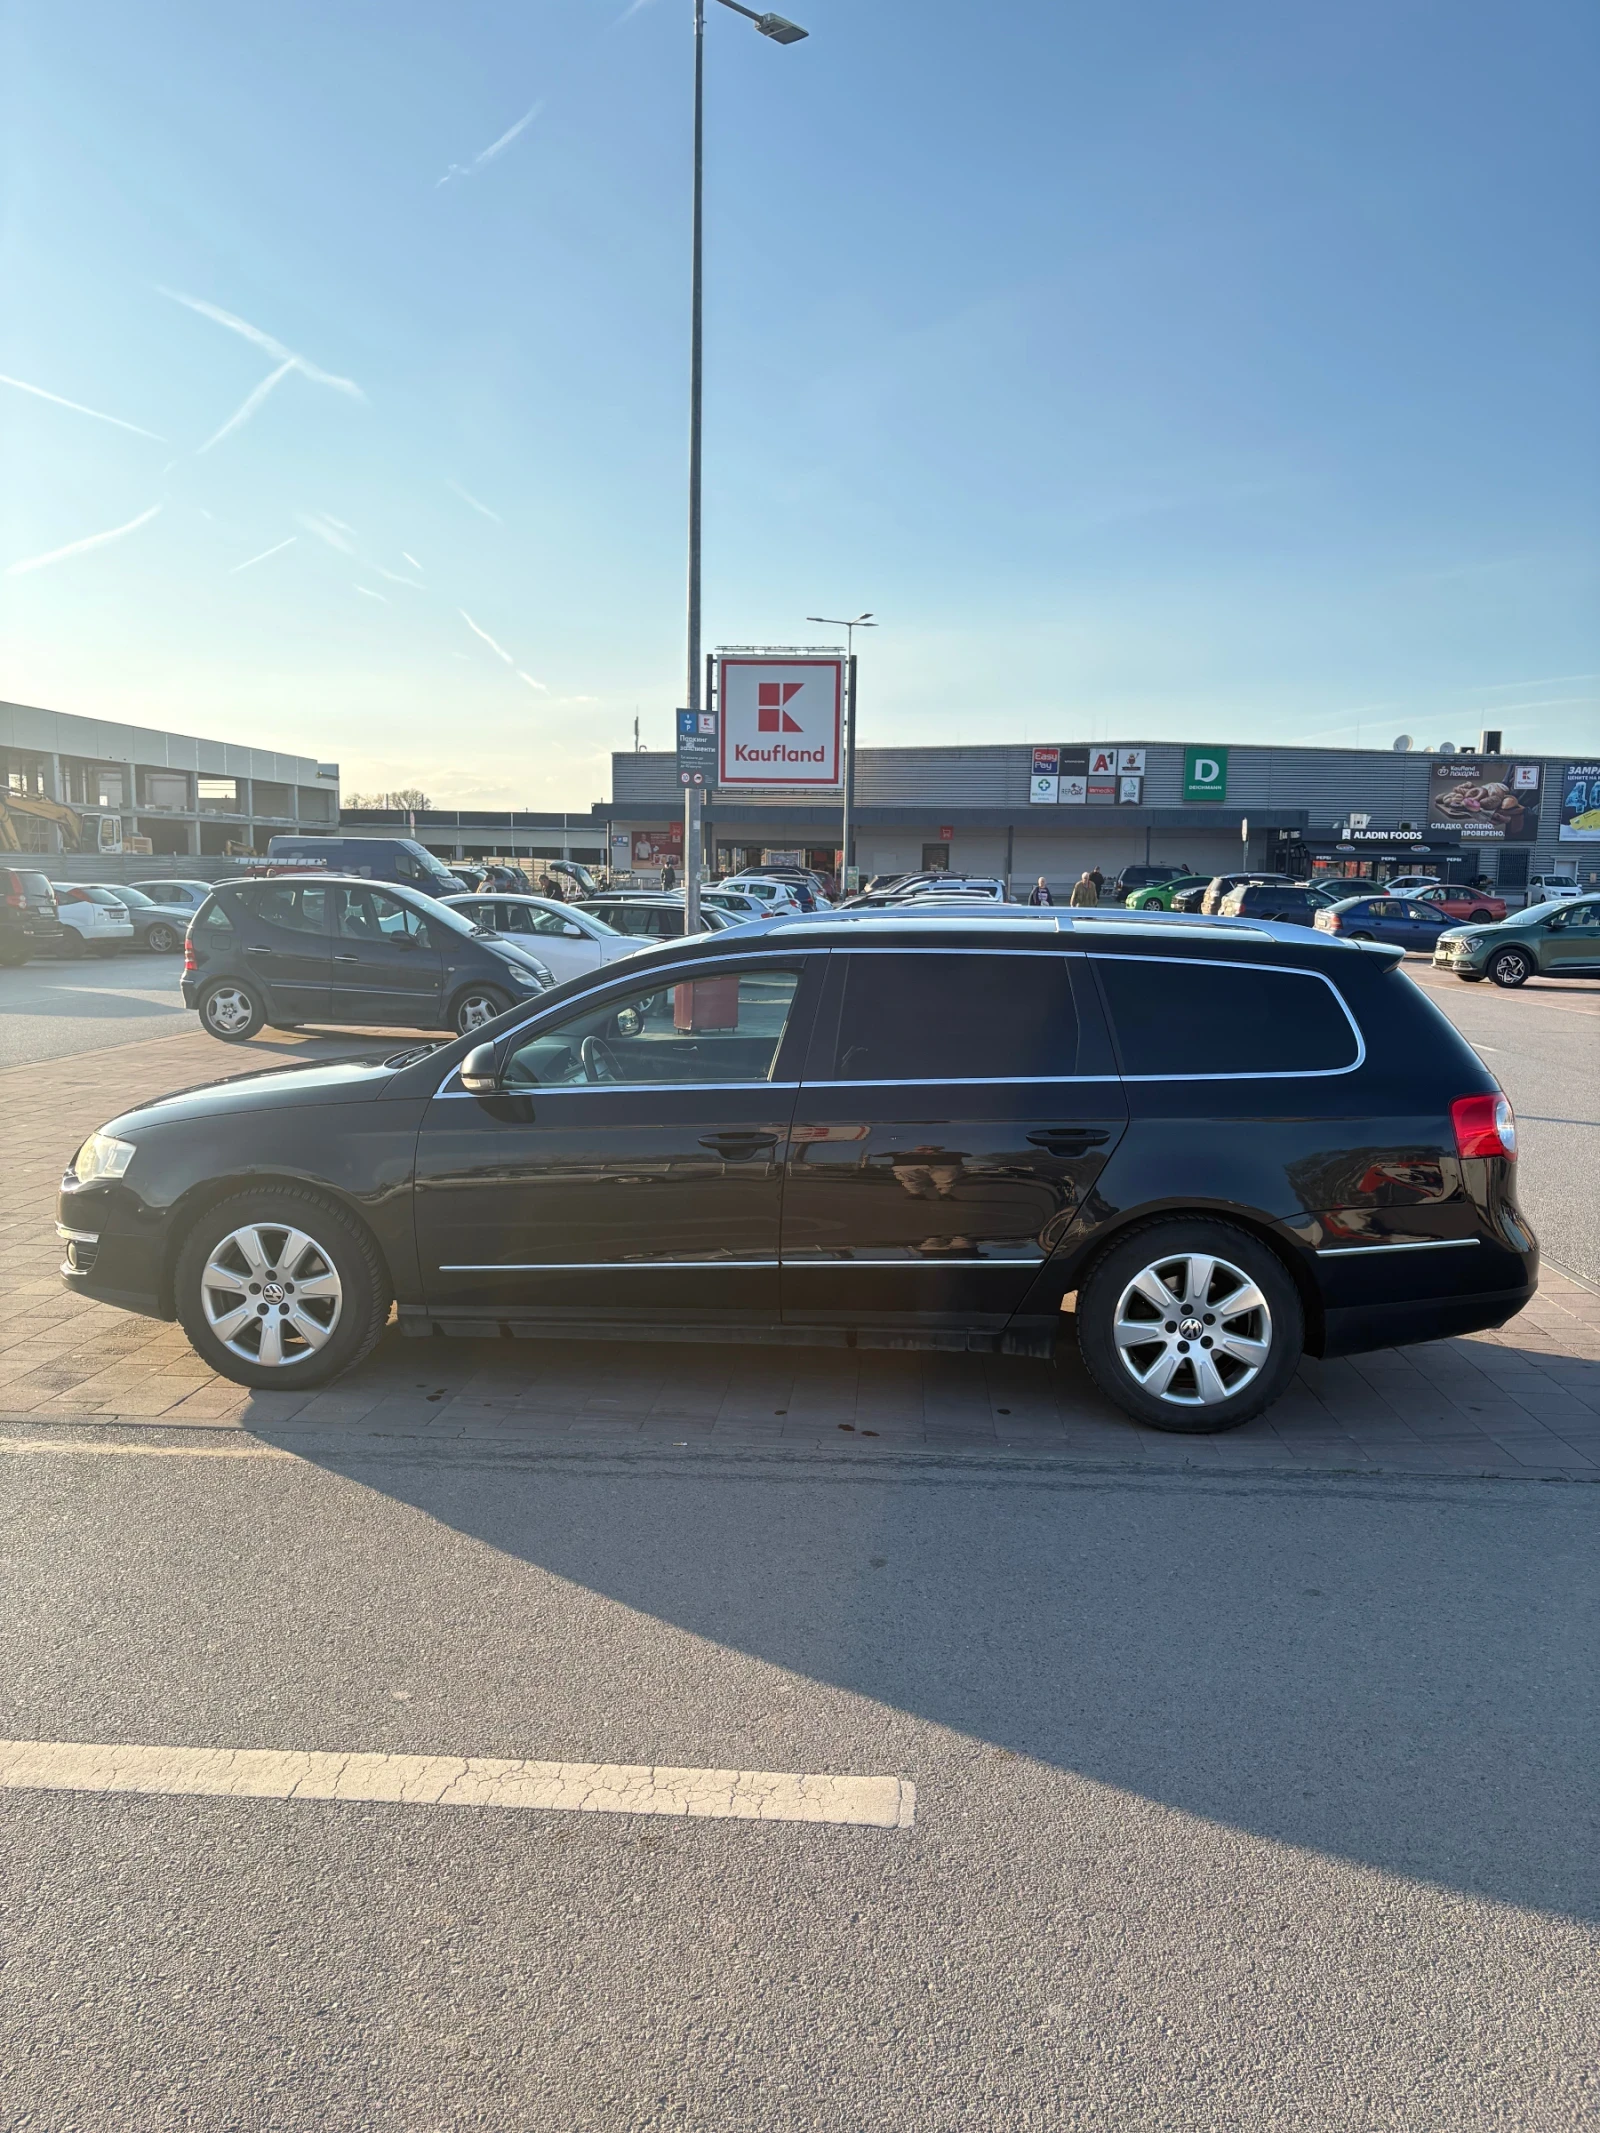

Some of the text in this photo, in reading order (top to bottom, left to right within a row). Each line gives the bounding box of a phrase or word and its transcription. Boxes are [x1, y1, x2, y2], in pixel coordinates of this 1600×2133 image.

[735, 744, 825, 763] Kaufland
[1035, 752, 1058, 762] Easy
[1035, 761, 1052, 771] Pay
[1092, 751, 1114, 772] A1
[1194, 758, 1220, 783] D
[1449, 770, 1480, 778] пекарна
[1353, 831, 1422, 840] ALADIN FOODS
